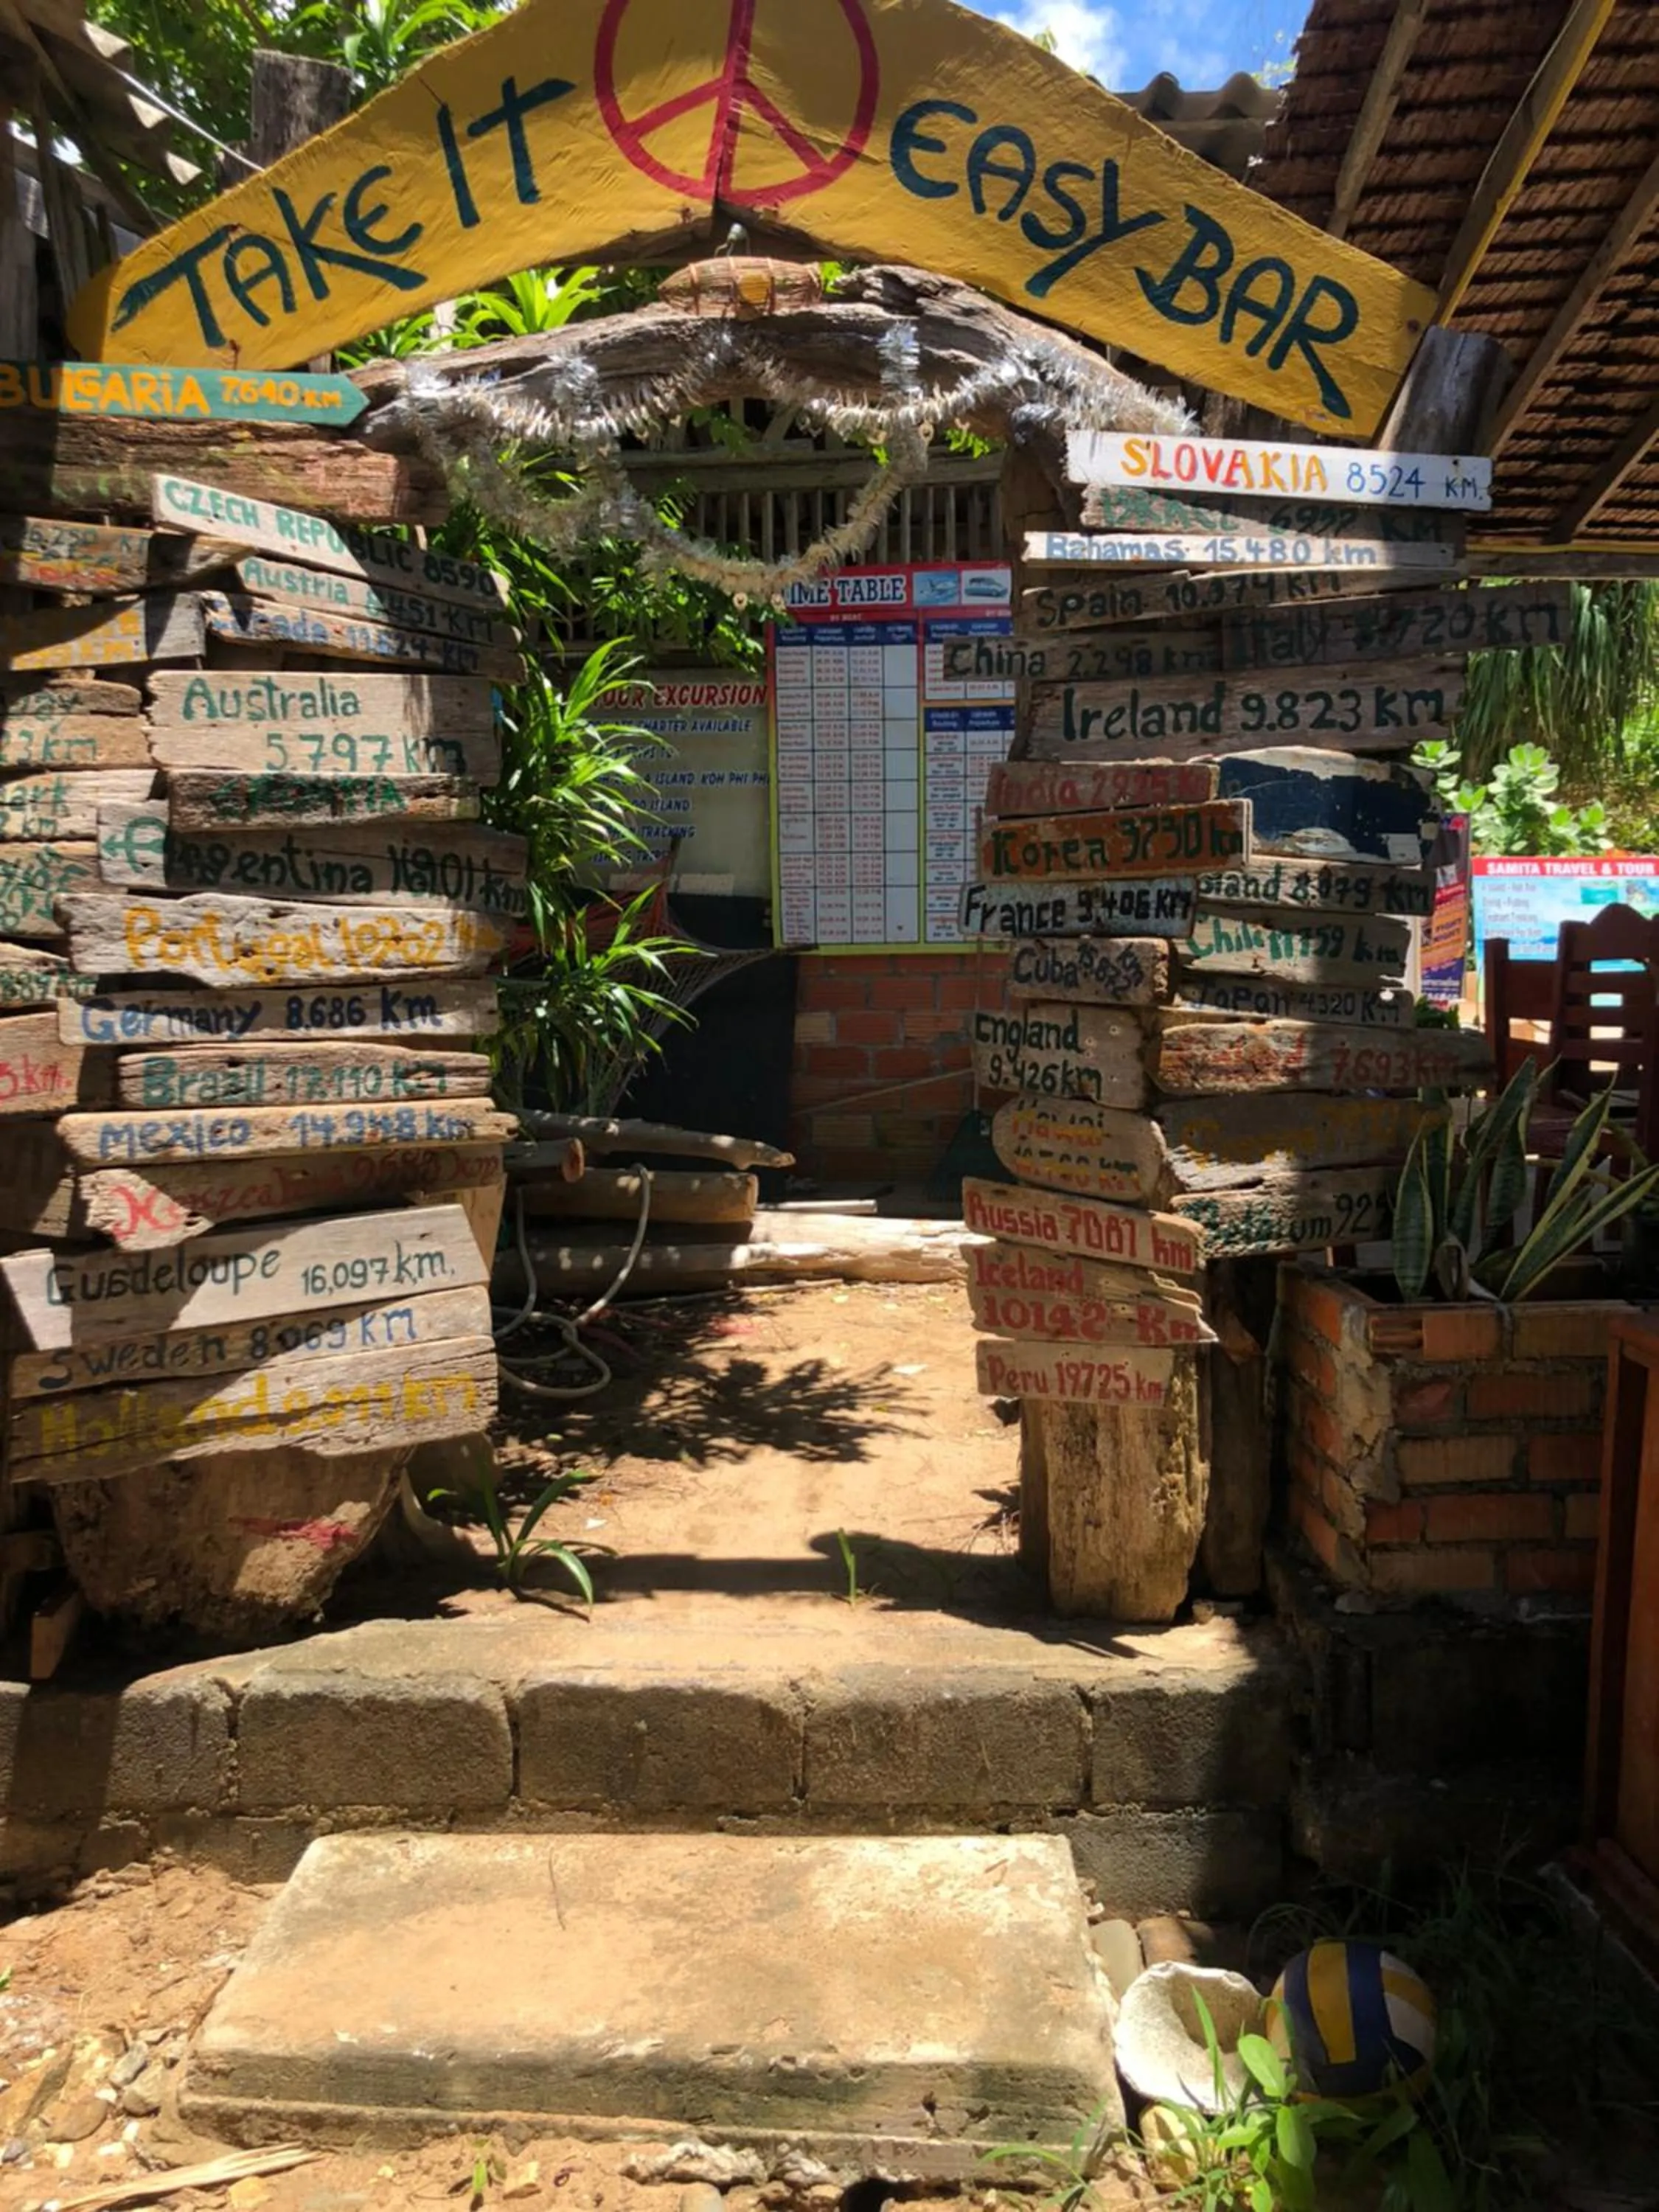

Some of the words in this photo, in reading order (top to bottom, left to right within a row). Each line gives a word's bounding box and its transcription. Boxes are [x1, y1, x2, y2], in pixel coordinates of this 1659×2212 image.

[110, 165, 427, 347] TAKE
[437, 75, 577, 228] IT
[889, 100, 1166, 297] EASY
[1135, 204, 1359, 418] BAR
[1120, 438, 1328, 494] SLOVAKIA
[1346, 462, 1425, 499] 8524
[164, 480, 260, 529] CZECH
[276, 509, 415, 574] REPUBLIC
[423, 550, 497, 596] 8590
[1204, 538, 1312, 563] 15.480
[244, 558, 349, 605] Austria
[790, 580, 829, 605] IME
[838, 577, 904, 603] TABLE
[949, 636, 1046, 678] China
[182, 677, 361, 722] Australia
[594, 686, 646, 709] OUR
[653, 684, 768, 706] EXCURSION
[1062, 681, 1227, 740] Ireland
[1240, 690, 1362, 732] 9.823
[991, 827, 1109, 876] Korea
[1486, 861, 1541, 875] SAMITA
[1545, 861, 1597, 875] TRAVEL
[1601, 861, 1613, 875] &
[1617, 861, 1655, 875] TOUR
[964, 884, 1067, 936] France
[1013, 947, 1079, 988] Cuba
[82, 998, 263, 1042] Germany
[285, 994, 367, 1031] 8.686
[975, 1006, 1083, 1062] England
[142, 1056, 266, 1105] Brazil
[965, 1190, 1058, 1240] Russia
[973, 1247, 1084, 1294] Iceland
[39, 1331, 227, 1389] Sweden
[987, 1354, 1049, 1393] Peru
